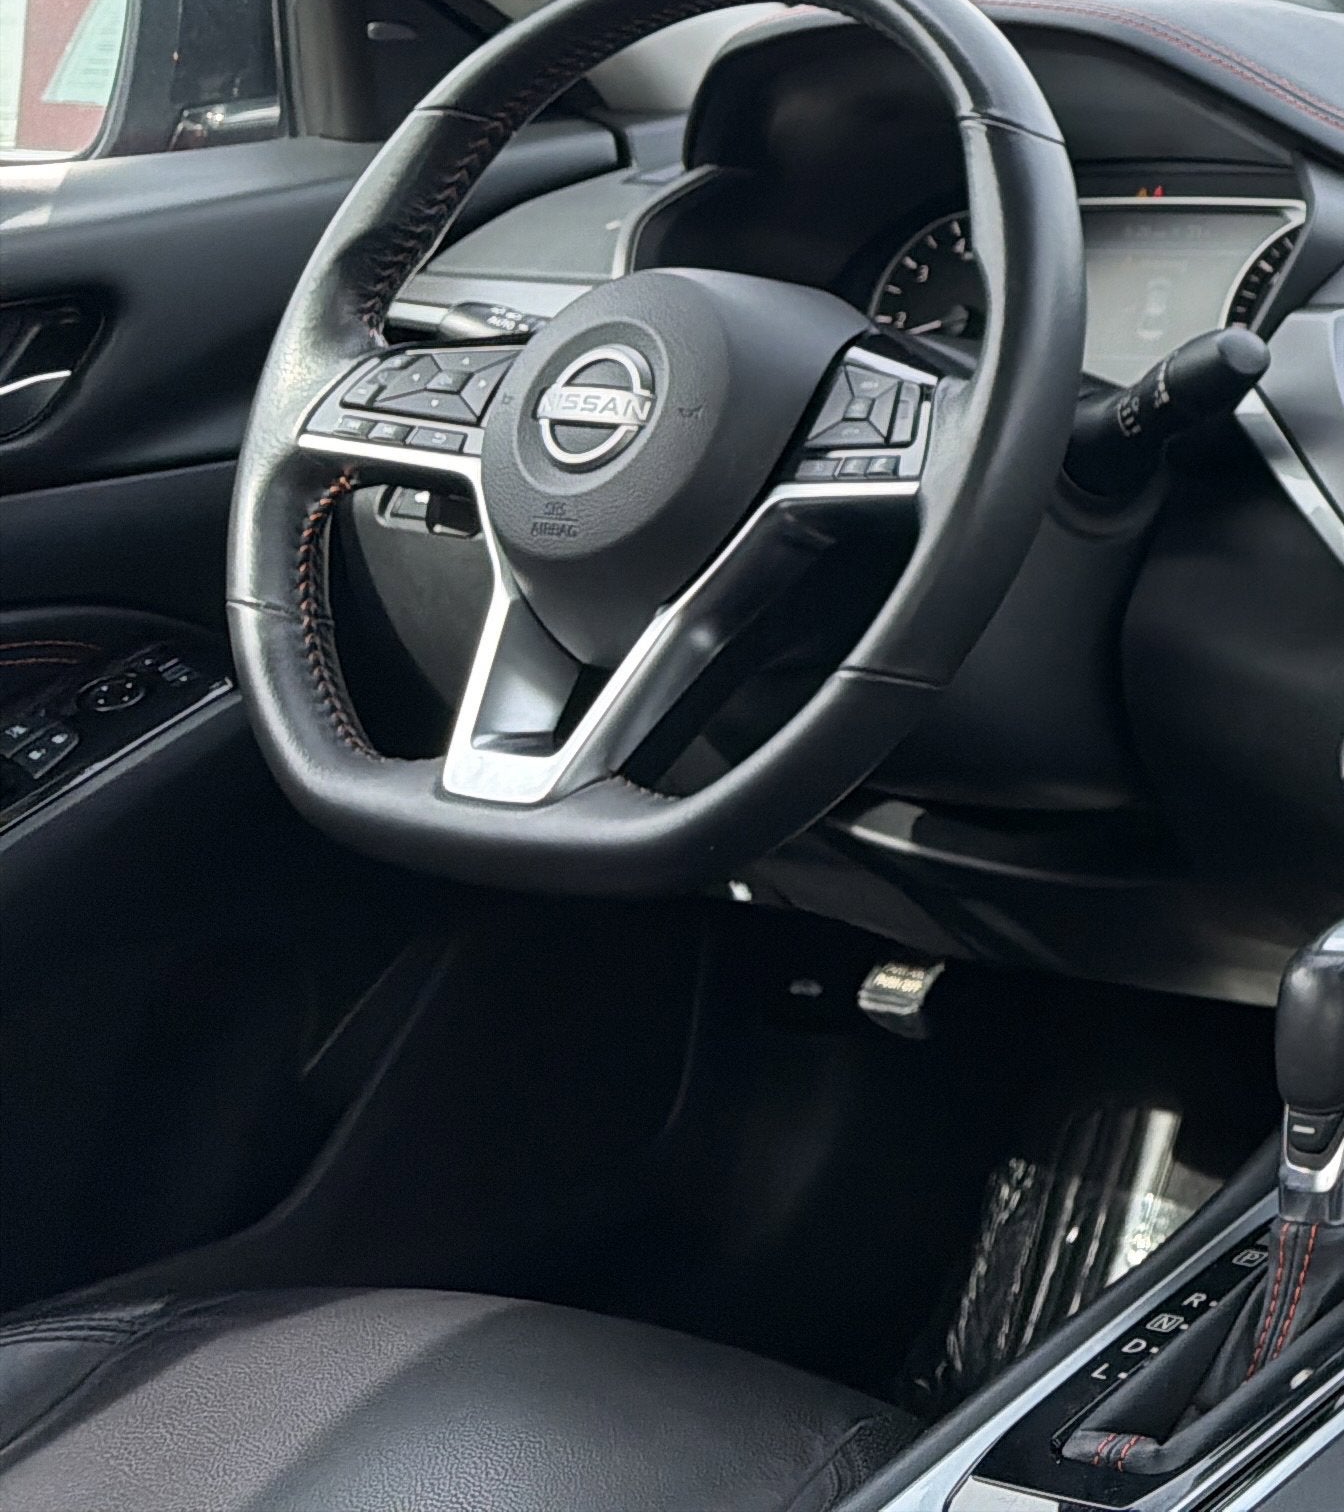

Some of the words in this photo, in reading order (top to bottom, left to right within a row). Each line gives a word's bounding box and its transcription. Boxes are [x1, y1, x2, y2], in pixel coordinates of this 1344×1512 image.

[535, 392, 652, 421] NISSAN
[1240, 1252, 1260, 1265] P
[1181, 1292, 1207, 1308] R
[1152, 1316, 1176, 1330] N
[1121, 1338, 1147, 1354] D
[1090, 1362, 1110, 1380] L
